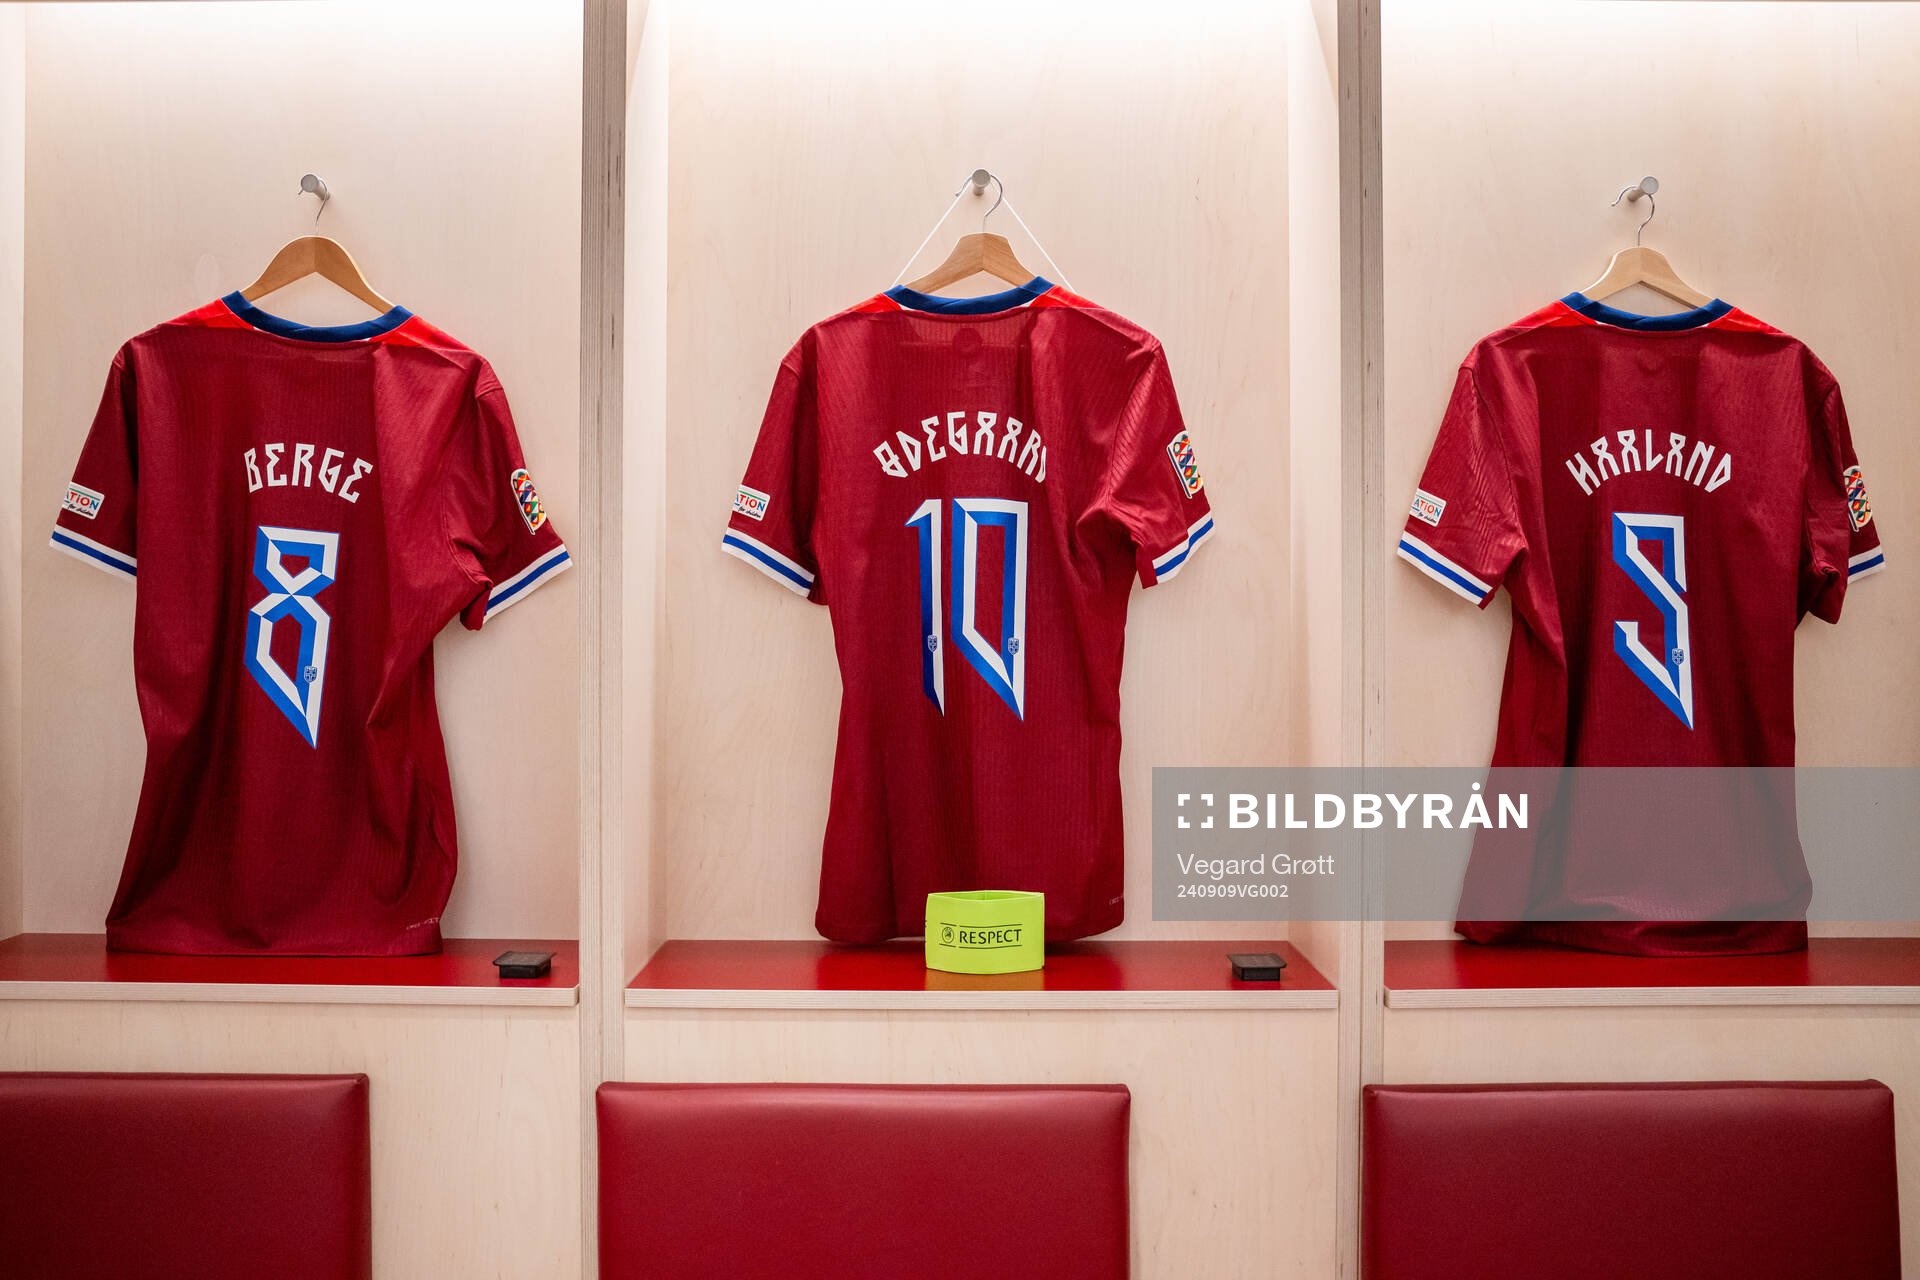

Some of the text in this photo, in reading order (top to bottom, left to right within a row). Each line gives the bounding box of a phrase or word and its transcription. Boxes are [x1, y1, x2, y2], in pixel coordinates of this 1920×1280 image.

[244, 443, 374, 503] BERGE
[1566, 429, 1732, 495] HAALAND
[244, 525, 340, 750] 8
[904, 497, 1028, 722] 10
[1612, 512, 1694, 731] 9
[959, 929, 1022, 945] RESPECT
